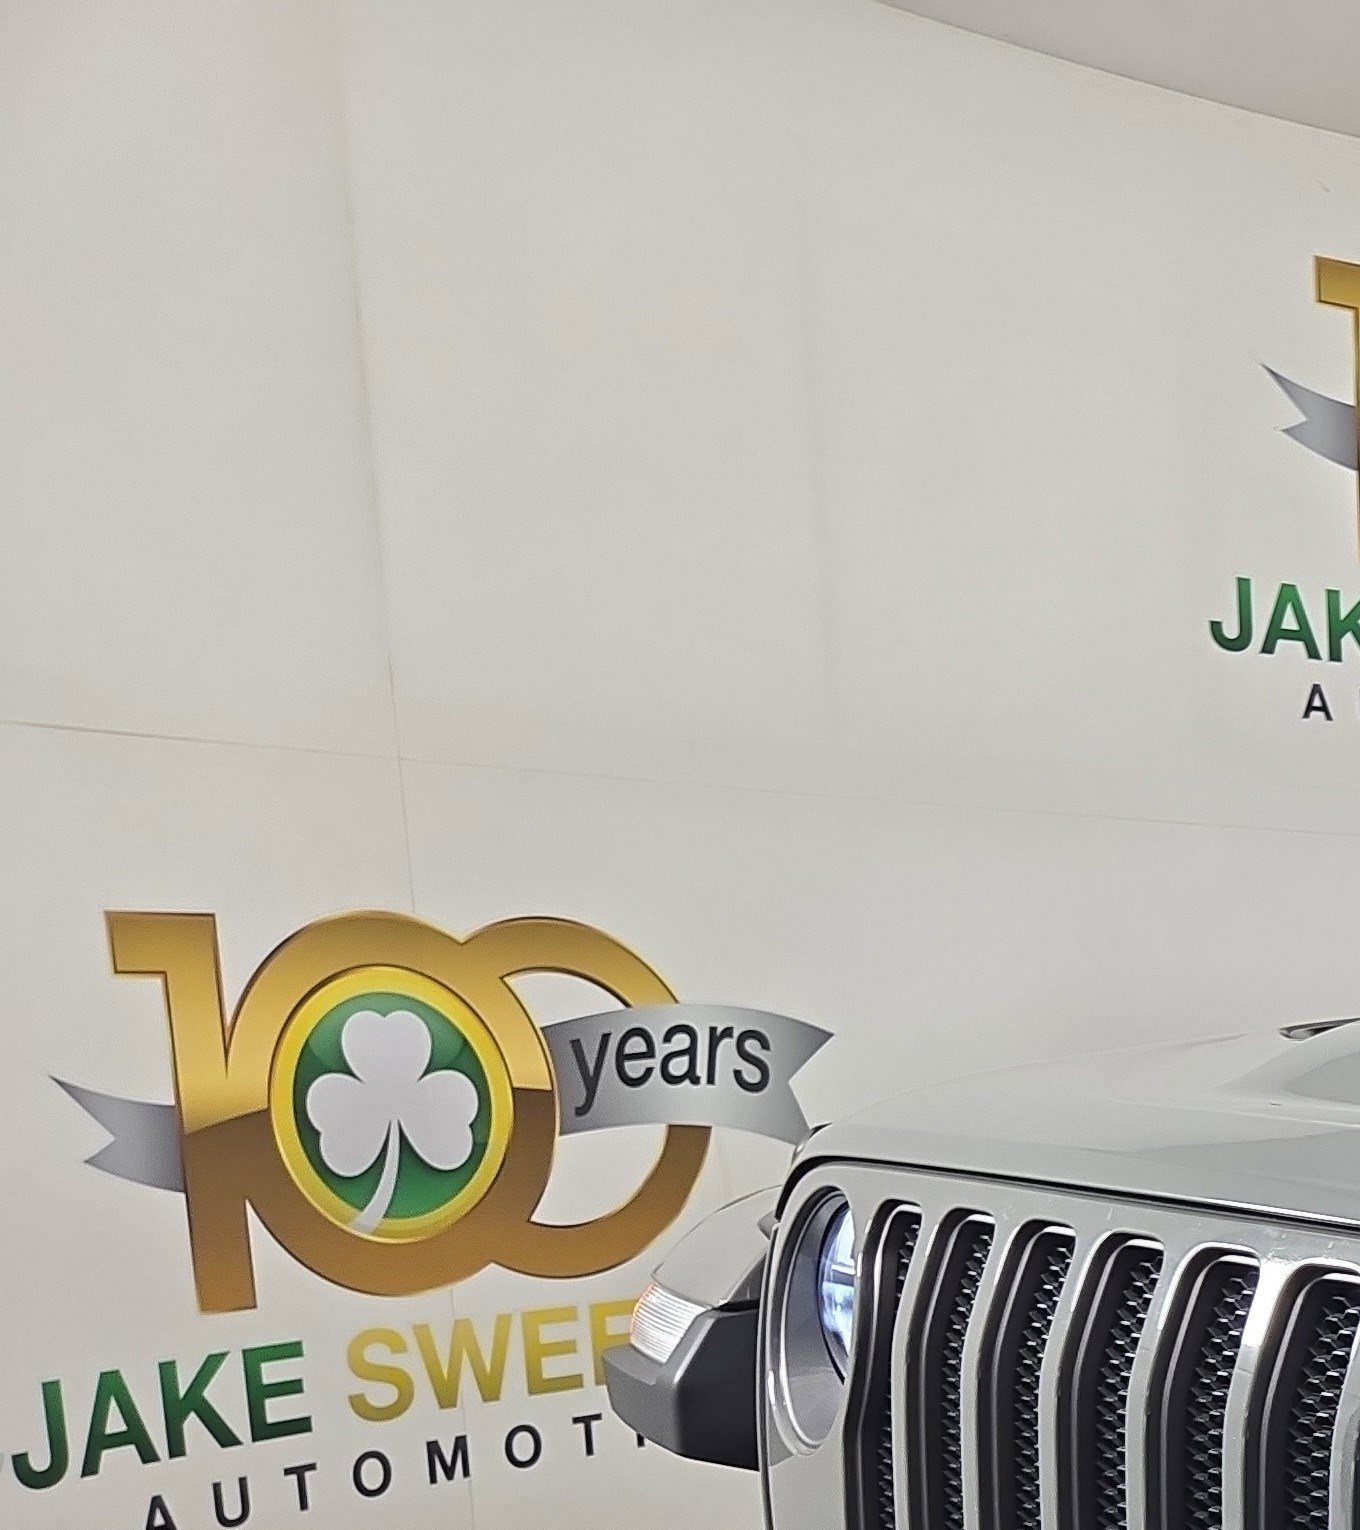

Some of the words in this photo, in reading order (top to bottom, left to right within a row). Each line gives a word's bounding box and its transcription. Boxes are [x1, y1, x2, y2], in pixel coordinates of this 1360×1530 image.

[569, 1020, 772, 1117] years
[10, 1339, 314, 1491] JAKE
[345, 1297, 641, 1423] SWEE
